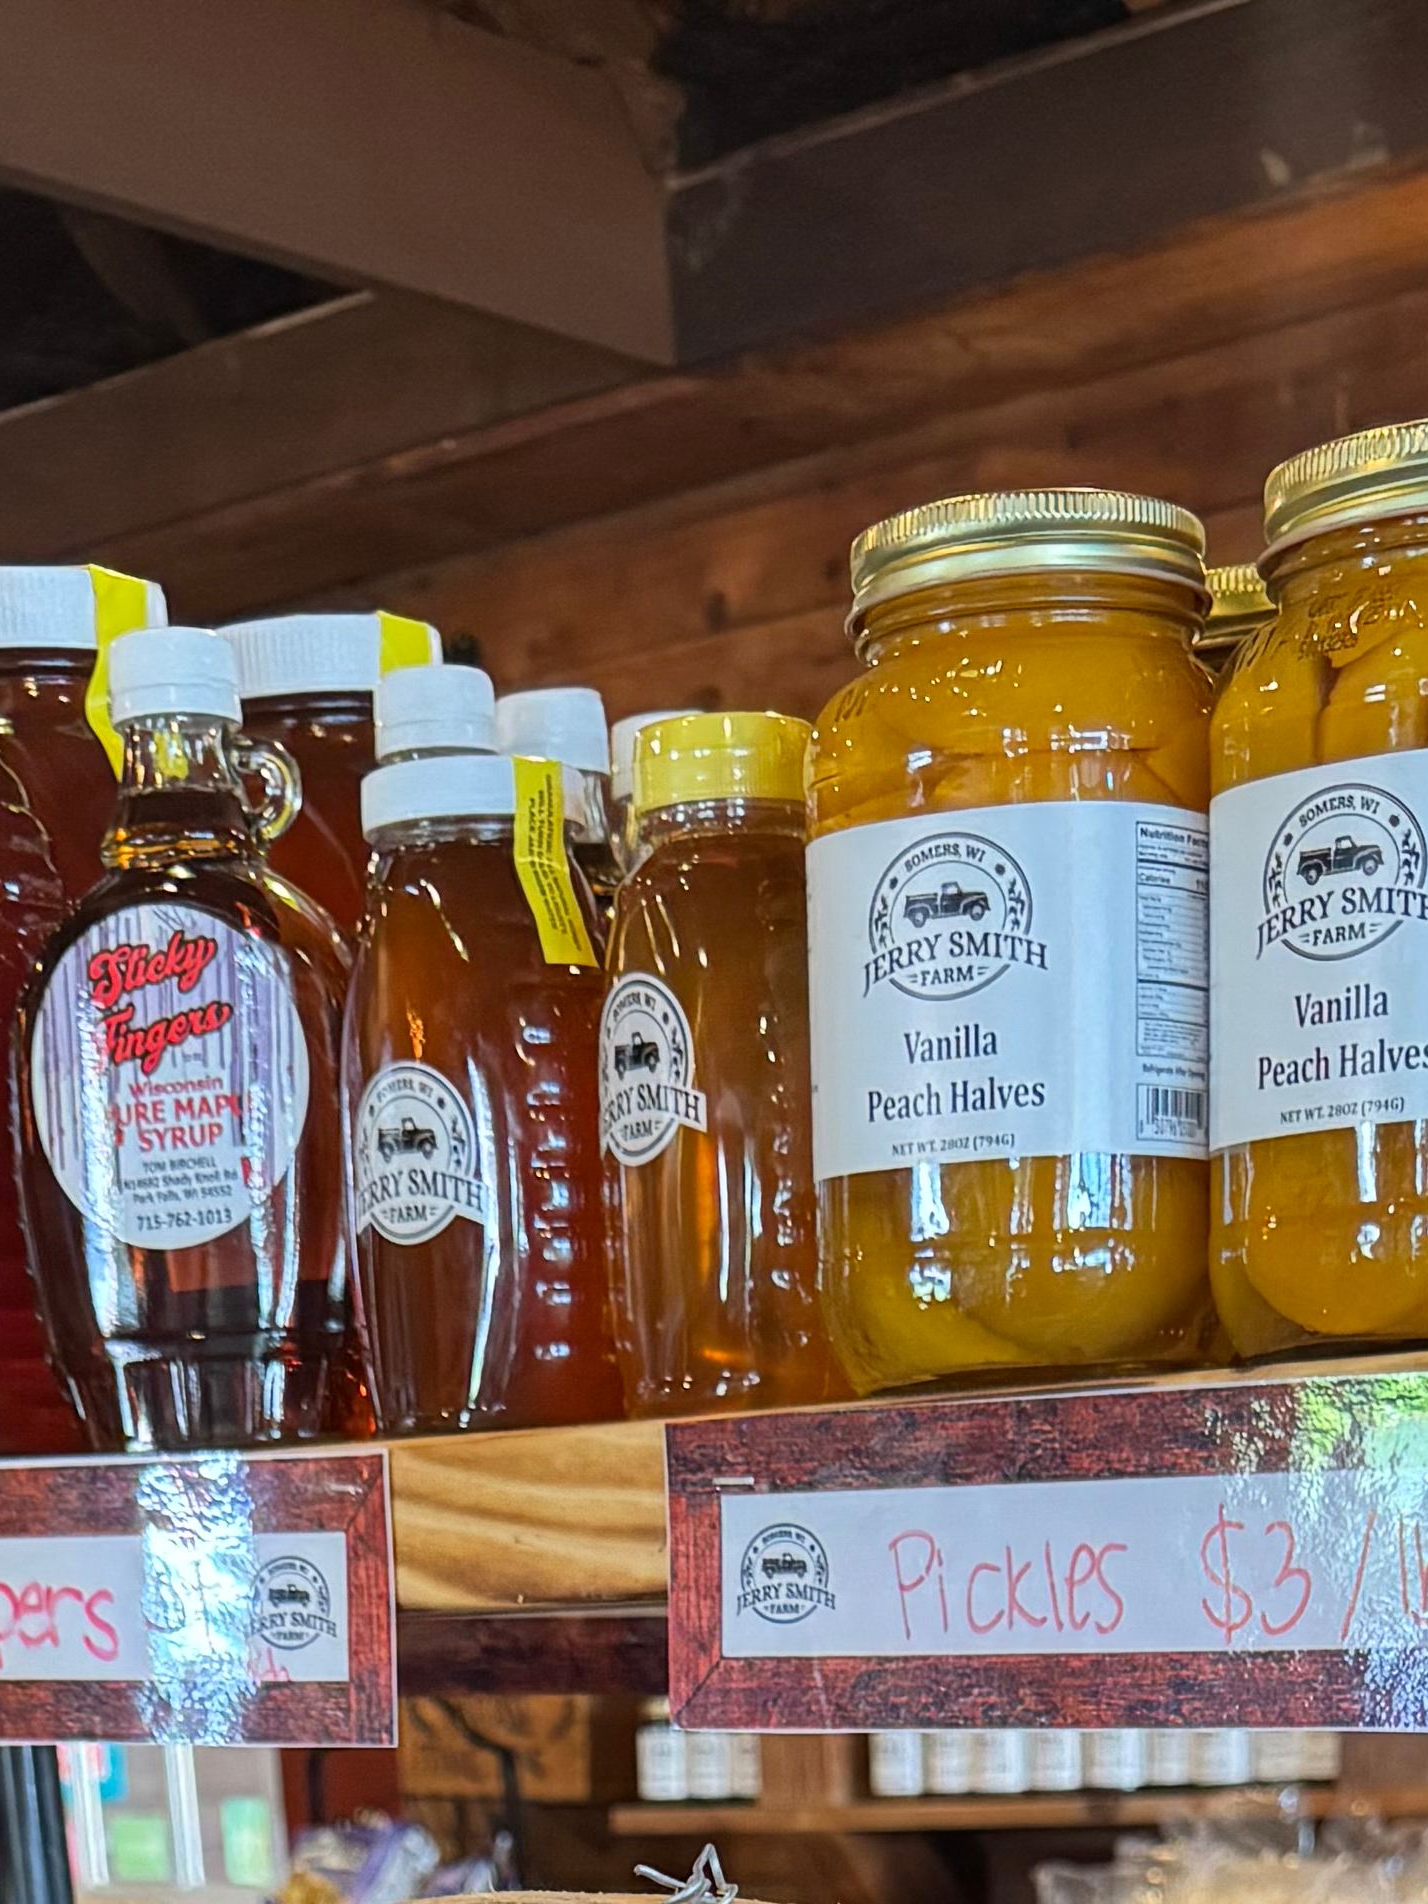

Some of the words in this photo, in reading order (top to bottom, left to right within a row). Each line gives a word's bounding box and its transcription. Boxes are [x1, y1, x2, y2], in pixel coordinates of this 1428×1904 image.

[1299, 795, 1357, 828] SOMERS,
[1361, 796, 1381, 815] WI
[965, 844, 987, 864] WI
[1256, 890, 1335, 960] JERRY
[1312, 922, 1366, 946] FARM
[87, 929, 218, 1010] Sticky
[862, 932, 942, 998] JERRY
[949, 930, 1048, 970] SMITH
[921, 964, 974, 987] FARM
[1293, 983, 1389, 1028] Vanilla
[102, 1000, 233, 1076] Fingers
[903, 1023, 998, 1064] Vanilla
[1258, 1046, 1330, 1090] Peach
[129, 1074, 223, 1099] Wisconsin
[637, 1082, 701, 1124] SMITH
[868, 1082, 942, 1123] Peach
[950, 1076, 1046, 1114] Halves
[109, 1100, 166, 1127] URE
[1280, 1109, 1302, 1125] NET
[1304, 1106, 1323, 1121] WT.
[1361, 1096, 1405, 1118] (794G)
[138, 1122, 224, 1152] SYRUP
[891, 1142, 914, 1157] NET
[972, 1132, 1016, 1152] (794G)
[408, 1167, 483, 1213] SMITH
[136, 1207, 233, 1232] 715-762-1013
[389, 1204, 428, 1224] FARM
[736, 1582, 782, 1616] JERRY
[786, 1582, 836, 1610] SMITH
[887, 1528, 1127, 1640] Pickles
[290, 1611, 337, 1638] SMITH
